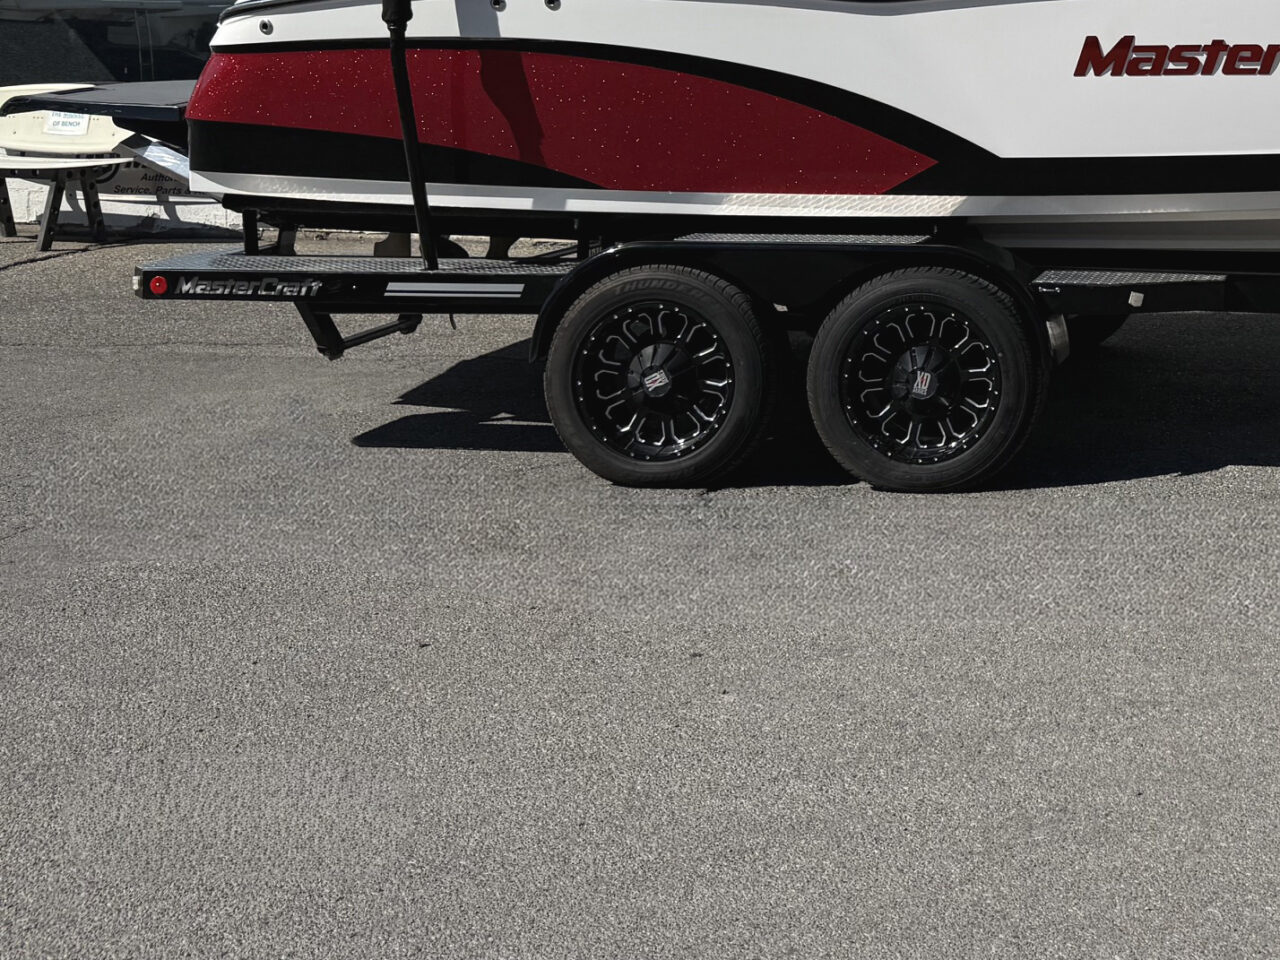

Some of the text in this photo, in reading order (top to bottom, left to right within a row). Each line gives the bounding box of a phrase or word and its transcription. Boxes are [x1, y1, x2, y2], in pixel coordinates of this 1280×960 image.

[155, 185, 182, 195] Parts
[175, 276, 323, 298] MasterCraft
[913, 370, 931, 389] XD
